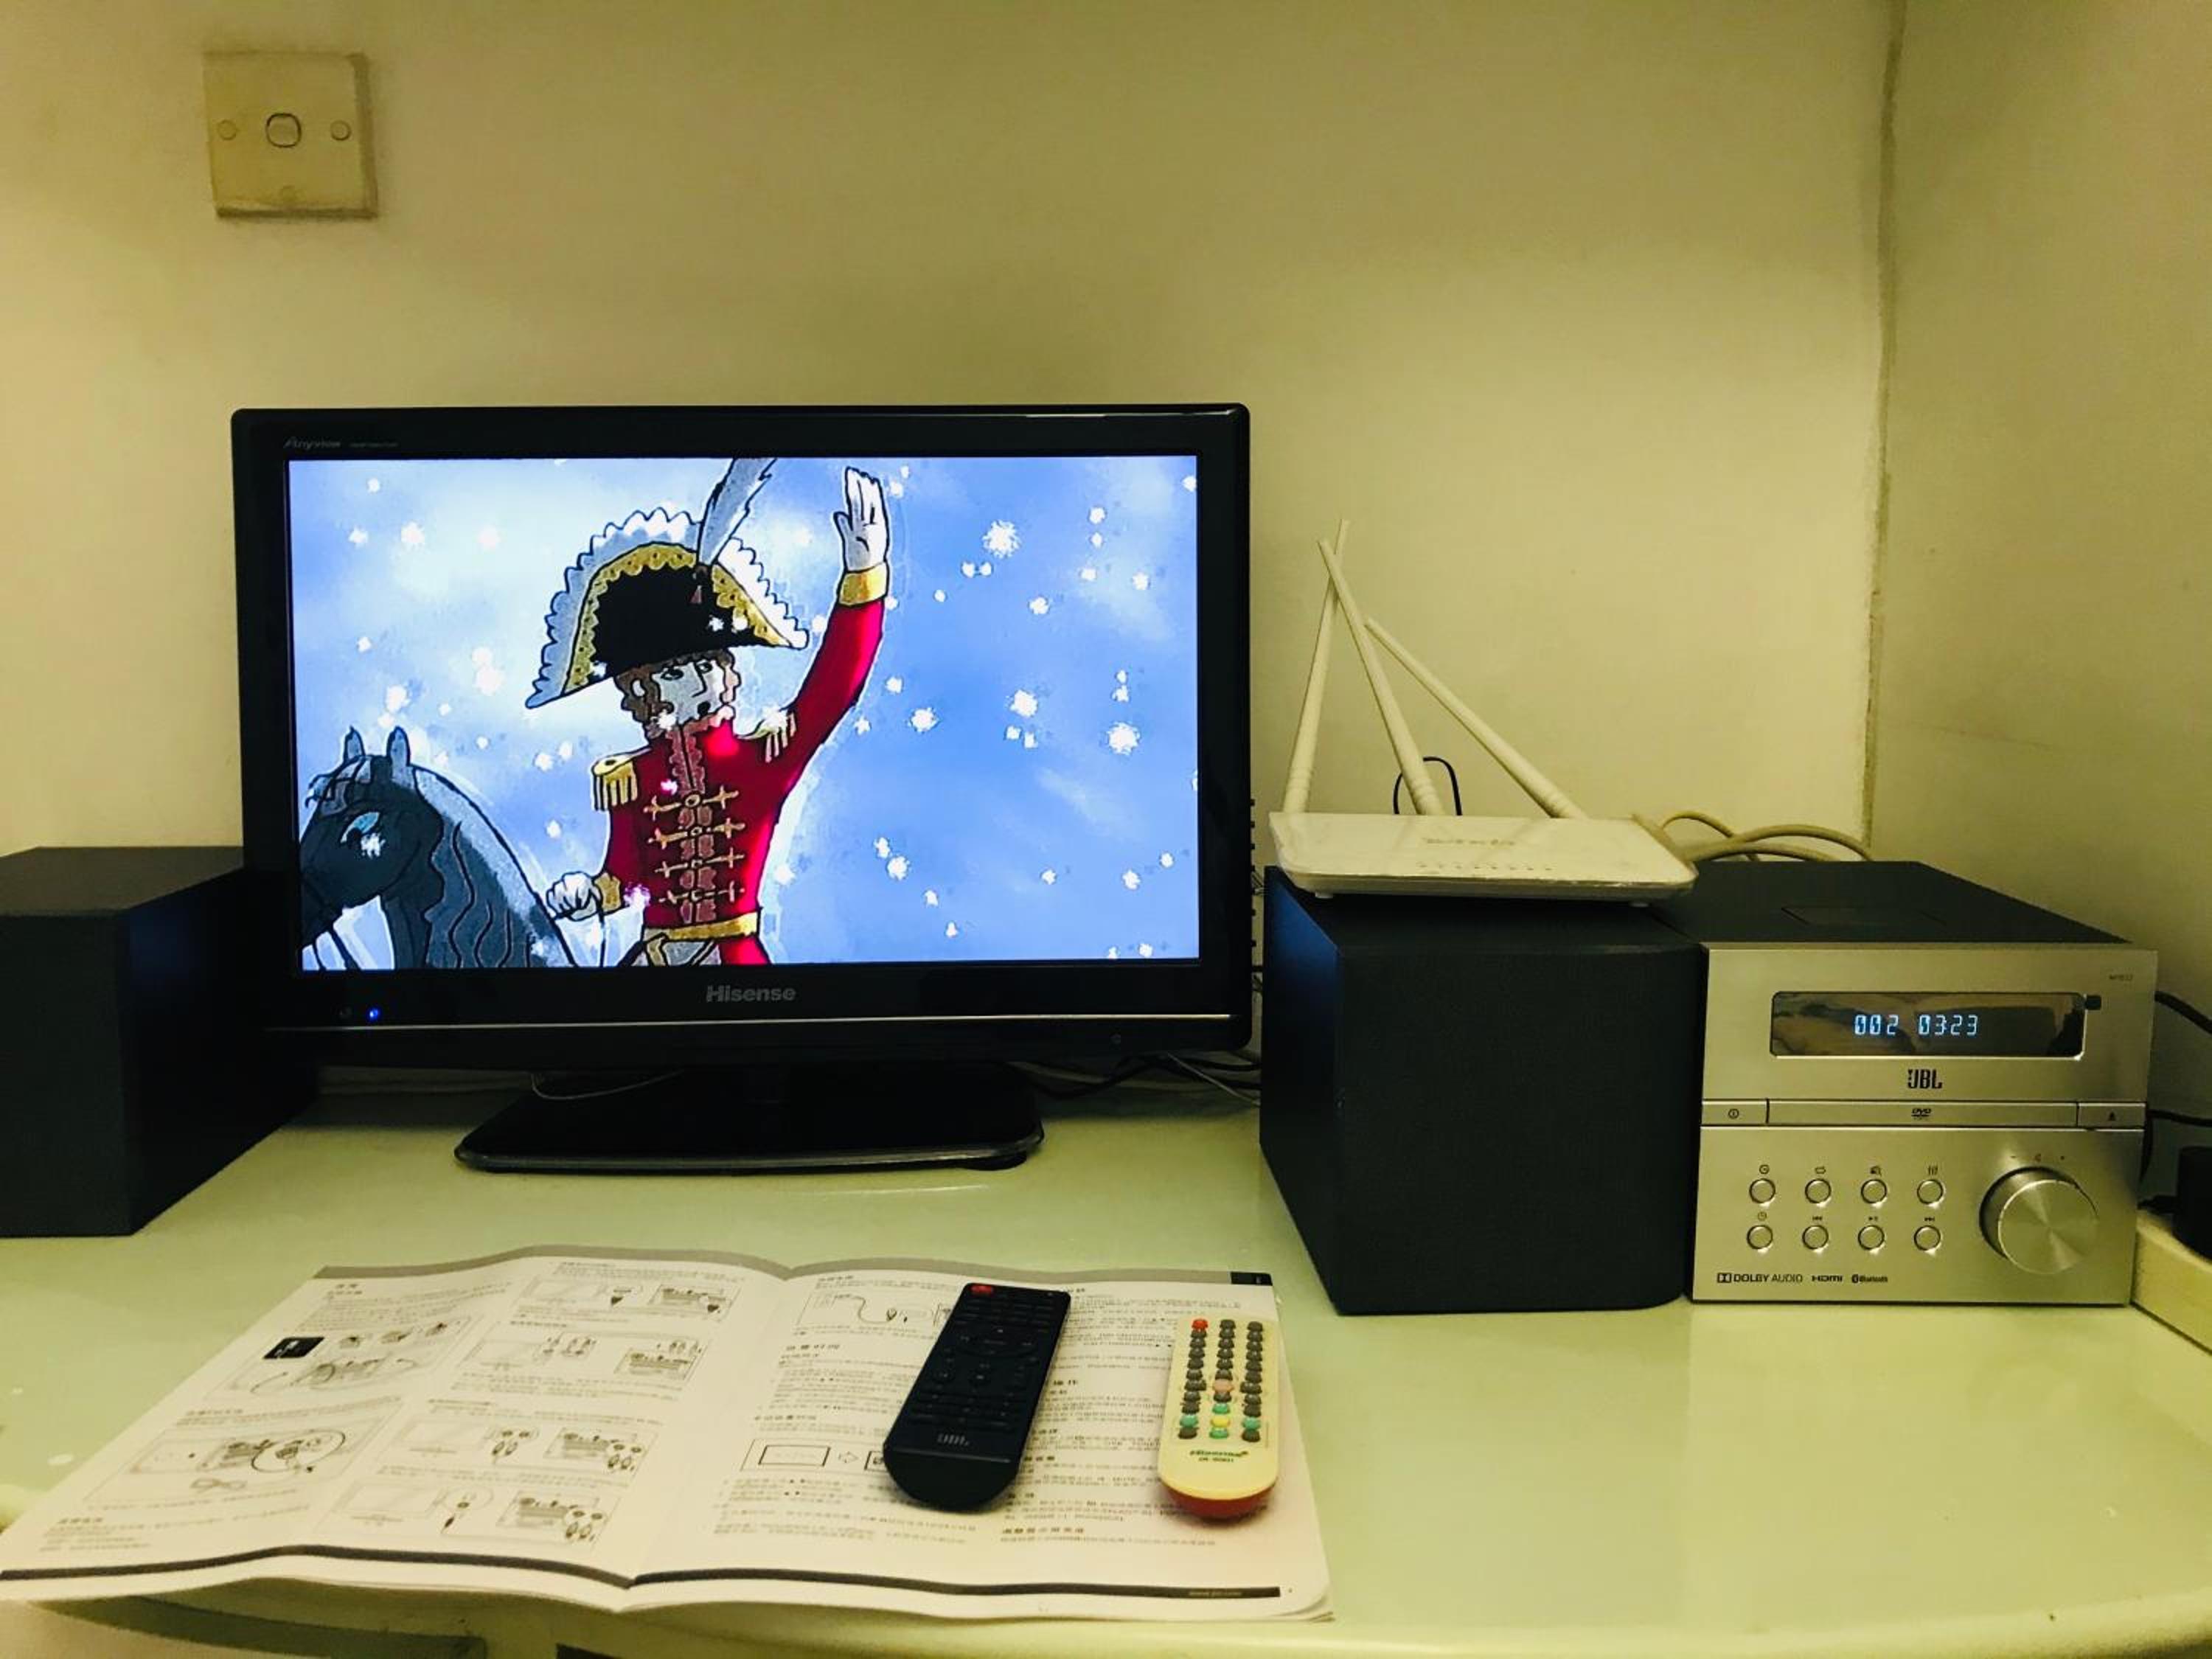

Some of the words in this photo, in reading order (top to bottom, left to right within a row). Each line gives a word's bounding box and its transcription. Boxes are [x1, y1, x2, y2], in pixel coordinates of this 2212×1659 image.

[706, 985, 796, 1002] Hisense
[1854, 1015, 1899, 1035] 002
[1907, 1069, 1942, 1089] JBL
[1733, 1273, 1769, 1282] DOLBY
[1771, 1273, 1803, 1282] AUDIO
